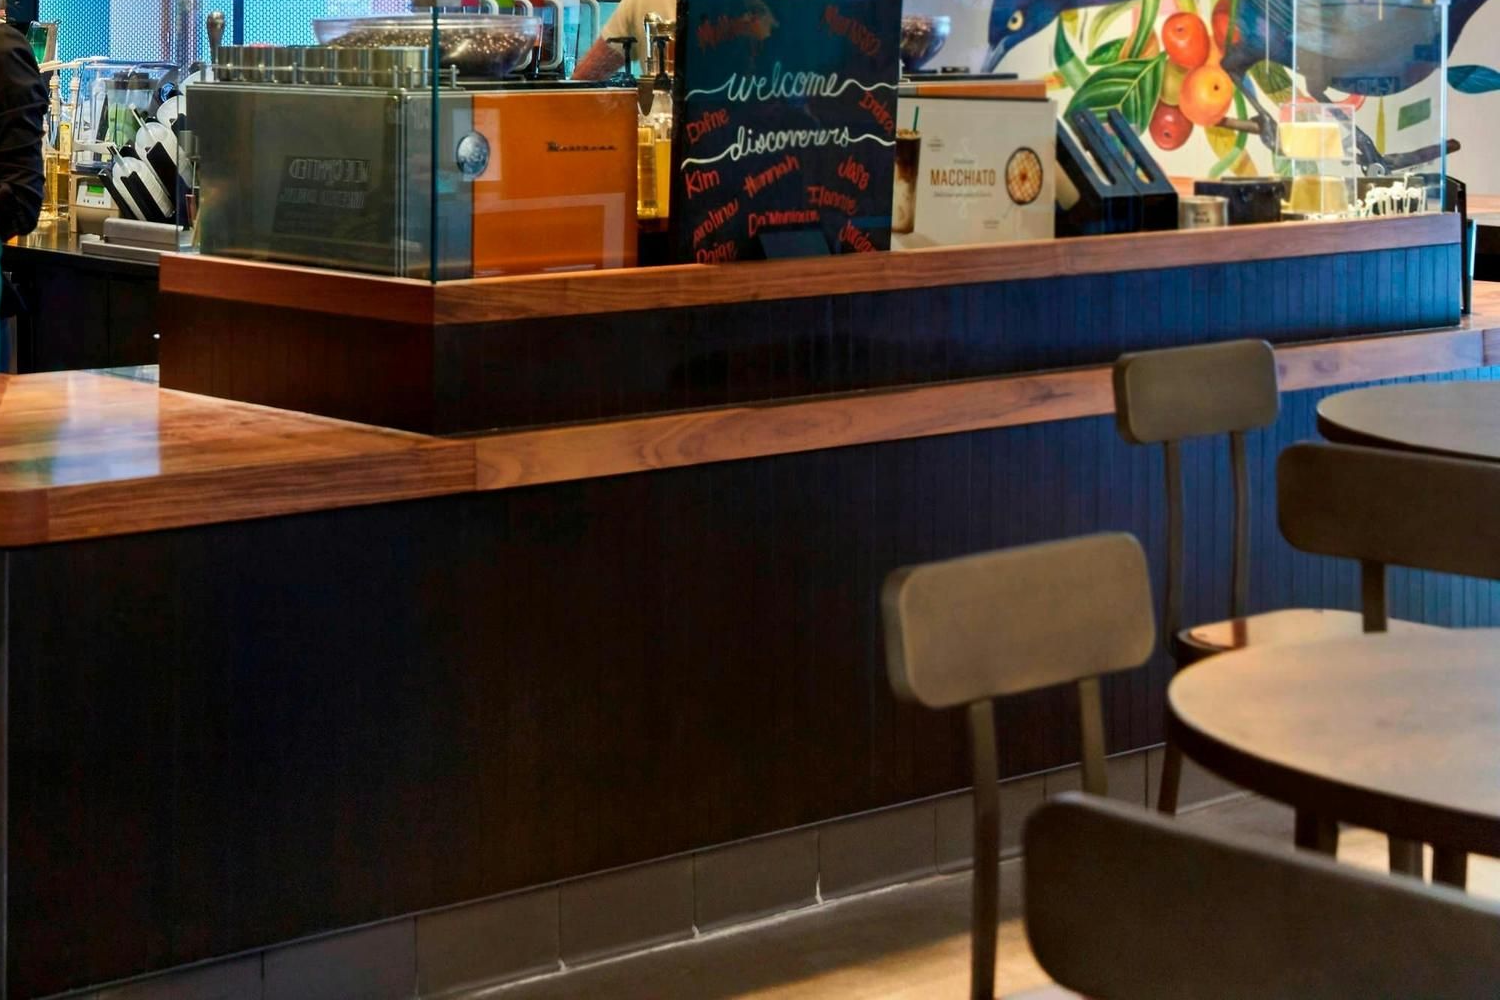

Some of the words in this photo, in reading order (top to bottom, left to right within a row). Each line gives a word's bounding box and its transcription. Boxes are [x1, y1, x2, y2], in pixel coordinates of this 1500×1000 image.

[716, 61, 848, 101] welcome
[727, 126, 852, 161] discoverers
[930, 168, 996, 186] MACCHIATO
